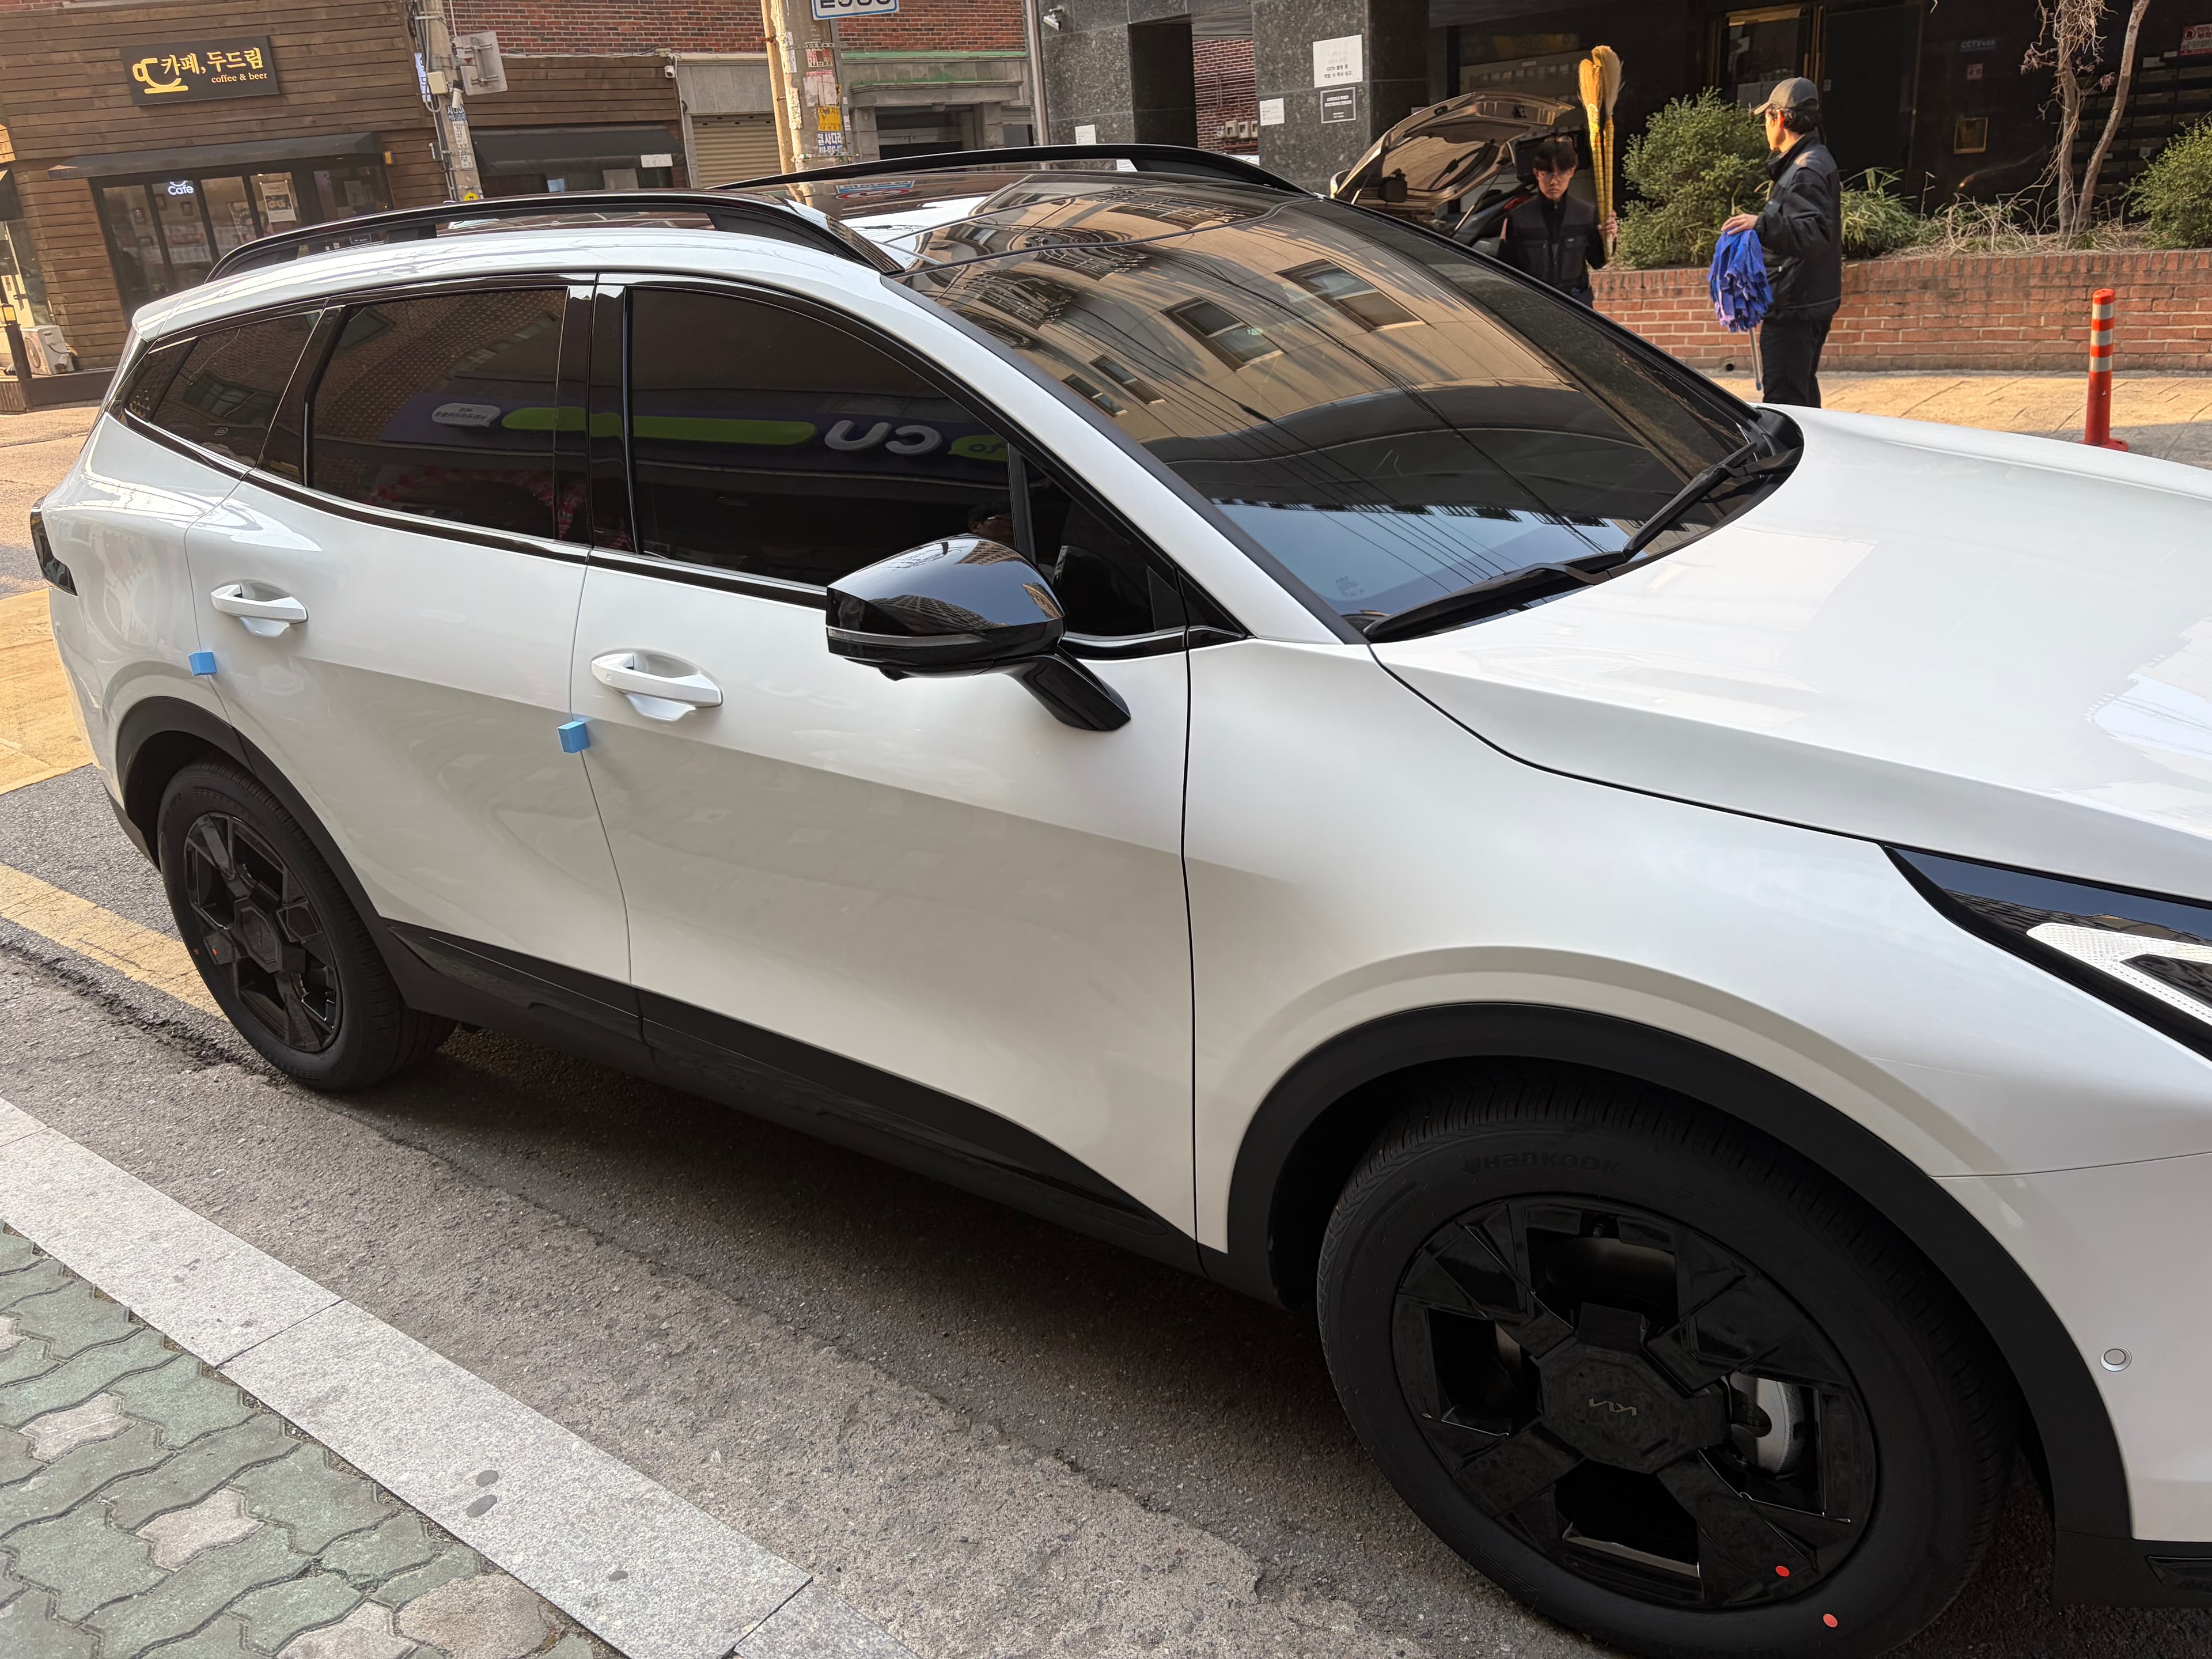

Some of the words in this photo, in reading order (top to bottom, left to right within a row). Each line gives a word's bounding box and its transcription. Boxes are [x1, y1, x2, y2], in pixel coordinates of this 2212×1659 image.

[211, 74, 237, 83] coffee
[240, 73, 247, 81] &
[248, 72, 268, 80] beer
[168, 185, 194, 195] Cafe
